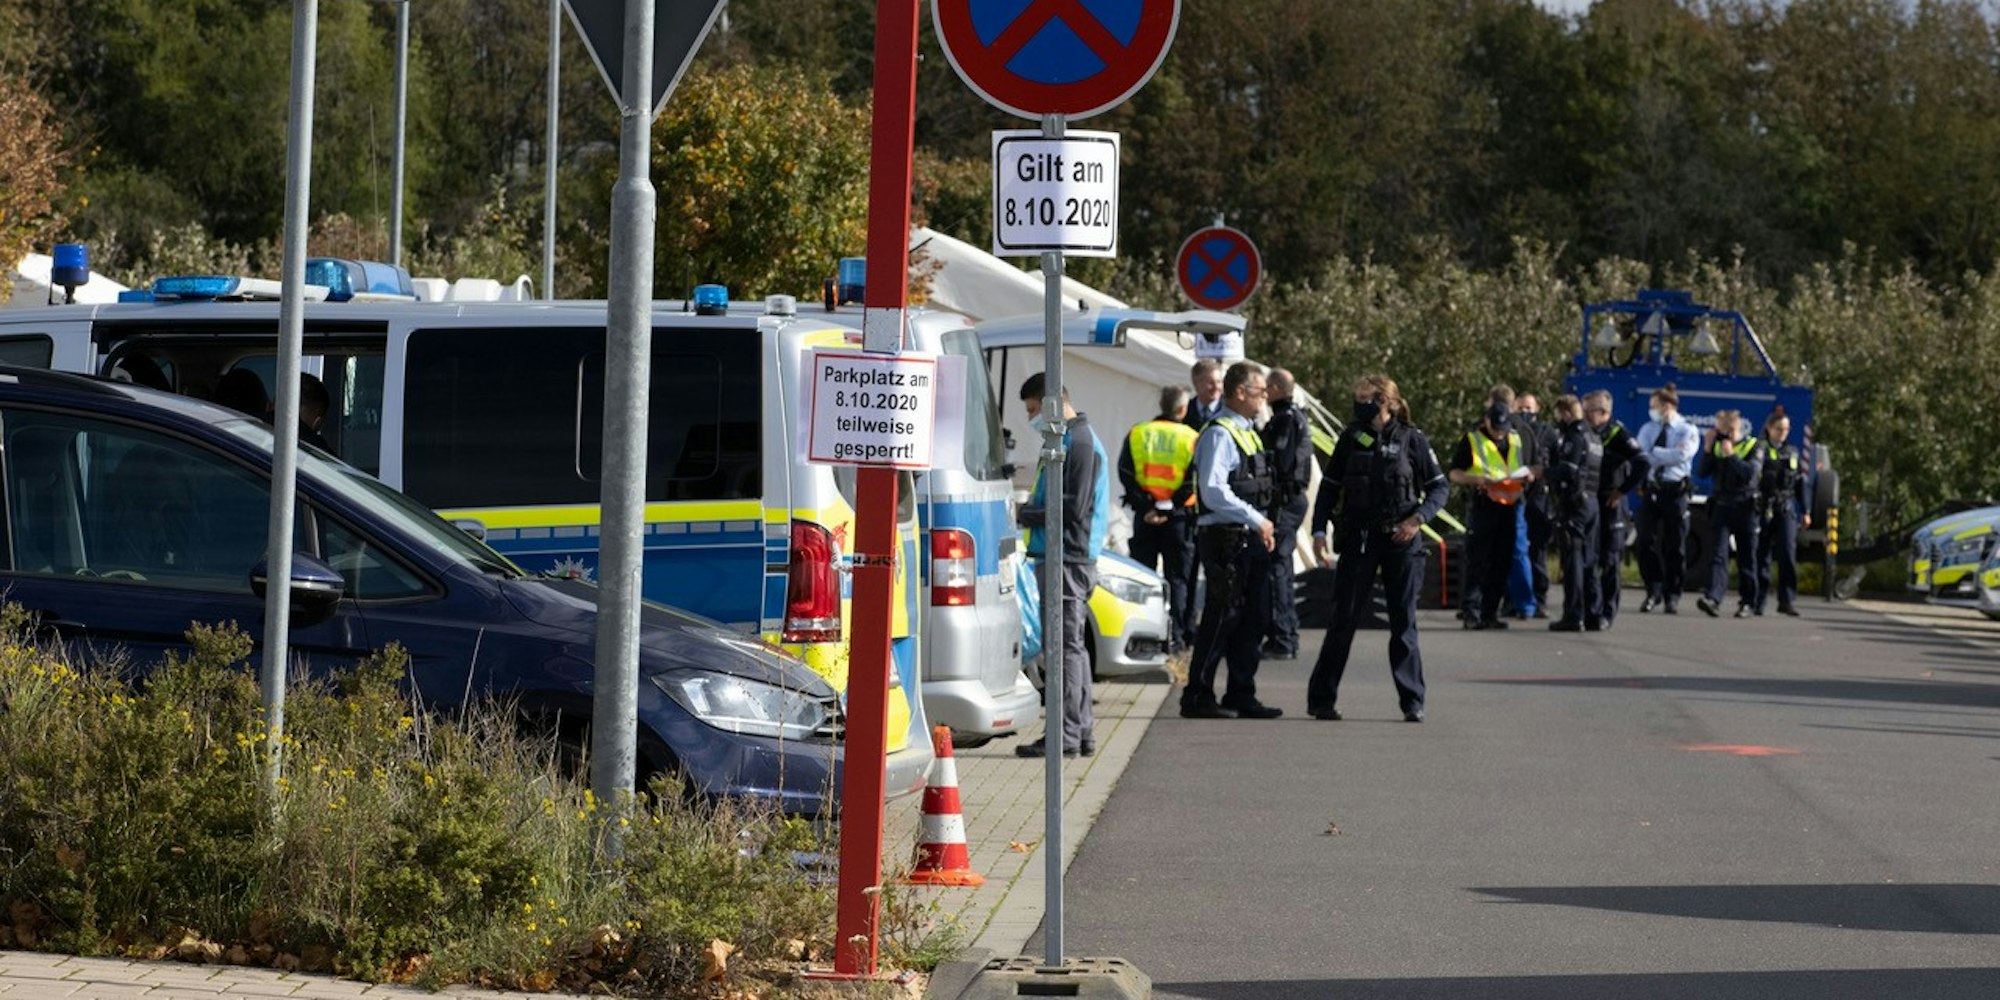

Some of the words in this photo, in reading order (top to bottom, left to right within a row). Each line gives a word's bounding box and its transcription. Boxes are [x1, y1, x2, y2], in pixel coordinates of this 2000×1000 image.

[1017, 153, 1064, 182] Gilt
[1073, 161, 1103, 183] am
[1005, 197, 1110, 227] 8.10.2020
[824, 366, 905, 388] Parkplatz
[910, 374, 929, 387] am
[836, 391, 918, 412] 8.10.2020
[837, 416, 915, 435] teilweise
[834, 442, 914, 460] gesperrt!
